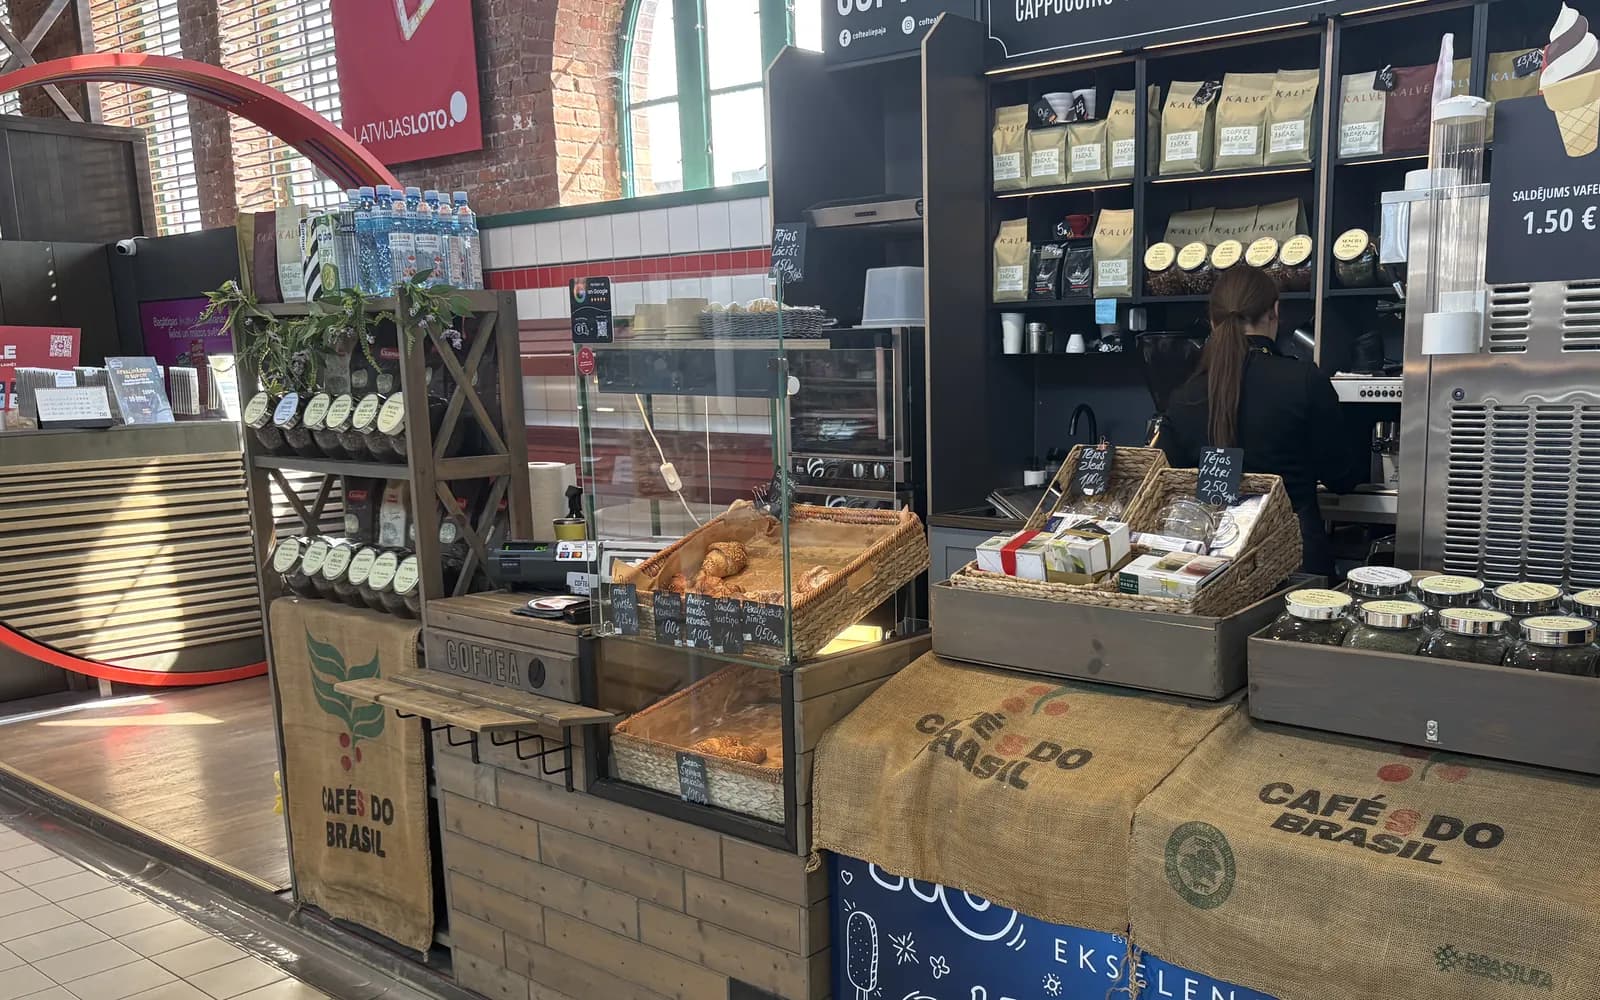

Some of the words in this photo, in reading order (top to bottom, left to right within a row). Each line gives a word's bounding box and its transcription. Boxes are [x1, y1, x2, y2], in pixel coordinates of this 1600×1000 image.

[1344, 92, 1383, 103] KALVE
[1391, 83, 1430, 97] KALVE
[1512, 186, 1570, 202] SALDĒJUMS
[1523, 207, 1574, 235] 1.50
[1581, 206, 1597, 230] €
[1203, 451, 1231, 470] Tējas
[446, 640, 521, 686] COFTEA
[1025, 740, 1093, 770] DO
[322, 785, 365, 818] CAFÉS
[371, 794, 395, 826] DO
[1258, 782, 1422, 836] CAFÉS
[1426, 813, 1506, 851] DO
[326, 821, 387, 858] BRASIL
[1270, 811, 1444, 866] BRASIL
